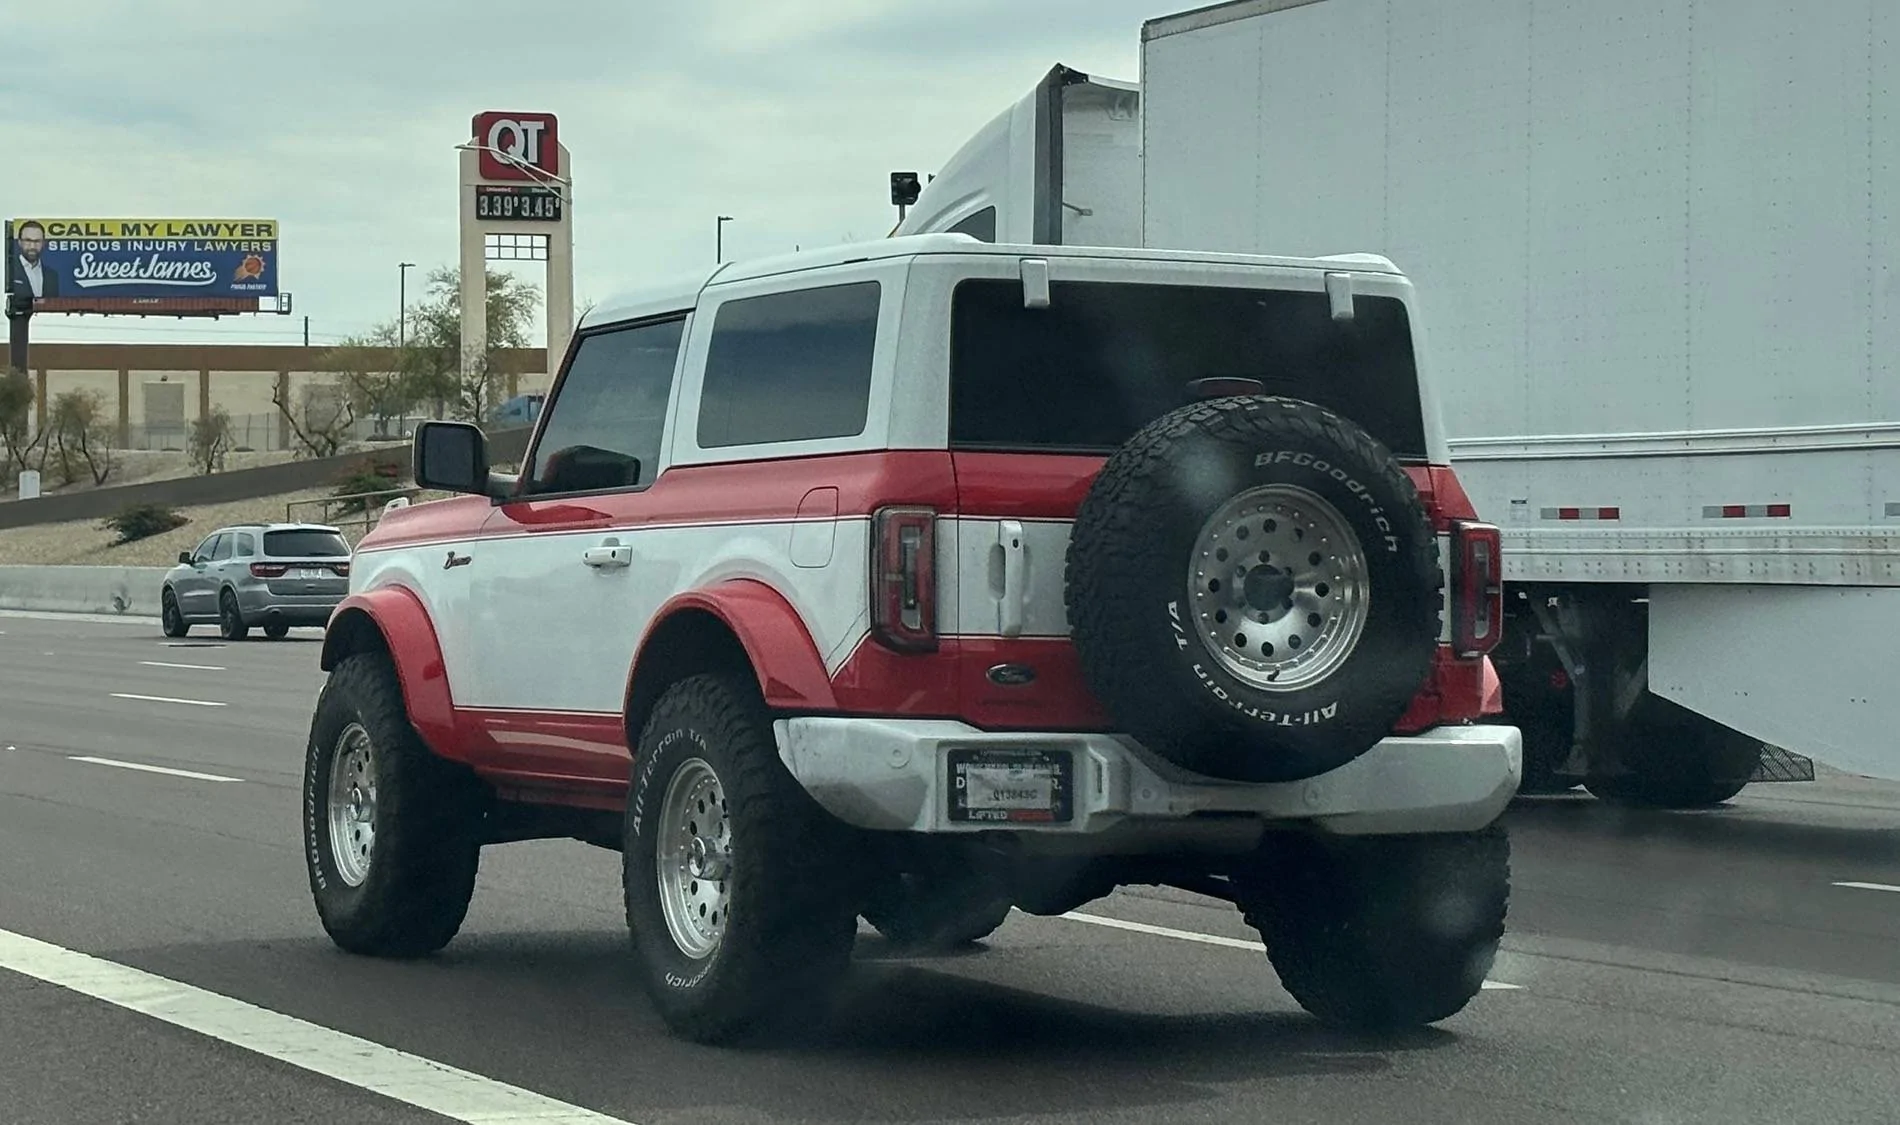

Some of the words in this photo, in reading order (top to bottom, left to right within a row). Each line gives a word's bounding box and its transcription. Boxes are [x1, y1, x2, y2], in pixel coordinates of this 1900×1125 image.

[488, 119, 545, 168] QT
[48, 223, 113, 237] CALL
[121, 224, 164, 237] MY
[173, 224, 273, 237] LAWYER
[48, 240, 121, 251] SERIOUS
[127, 241, 186, 252] INJURY
[194, 241, 272, 252] LAWYERS
[1254, 451, 1398, 553] BFGoodrich
[1192, 663, 1342, 727] All-Terrain
